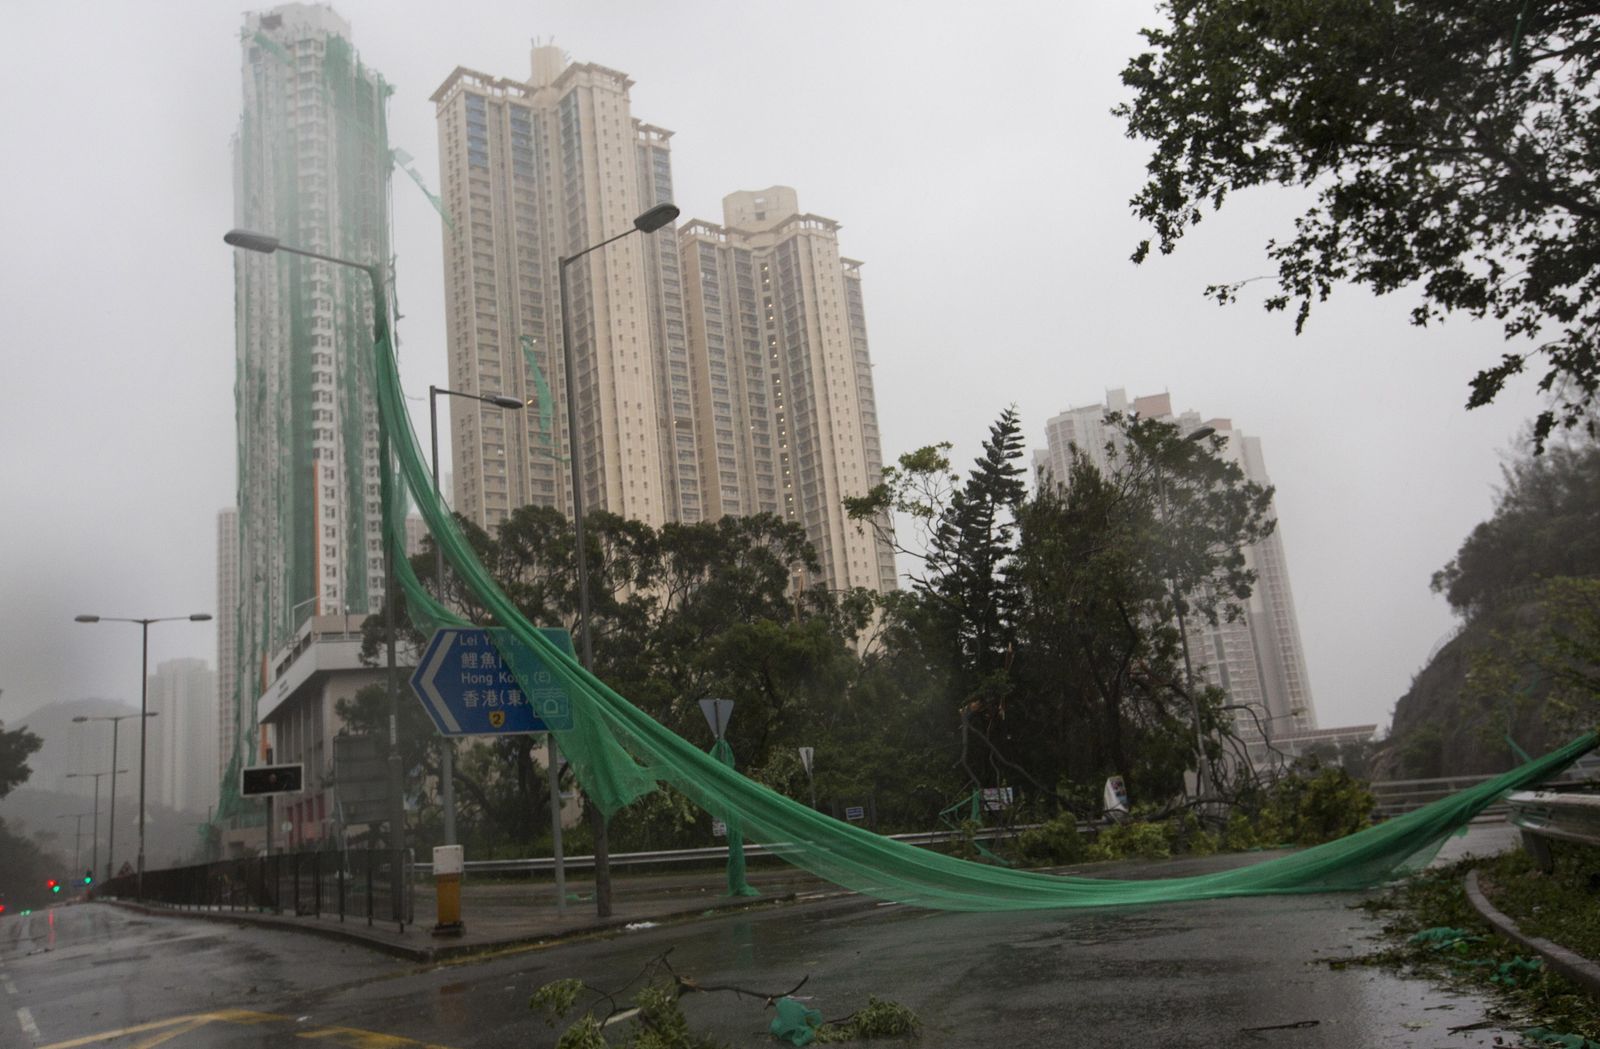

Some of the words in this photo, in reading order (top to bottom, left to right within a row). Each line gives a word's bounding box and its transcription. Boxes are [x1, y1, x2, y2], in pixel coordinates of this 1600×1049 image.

[459, 633, 478, 646] Lei
[461, 671, 493, 686] Hong
[492, 713, 501, 725] 2
